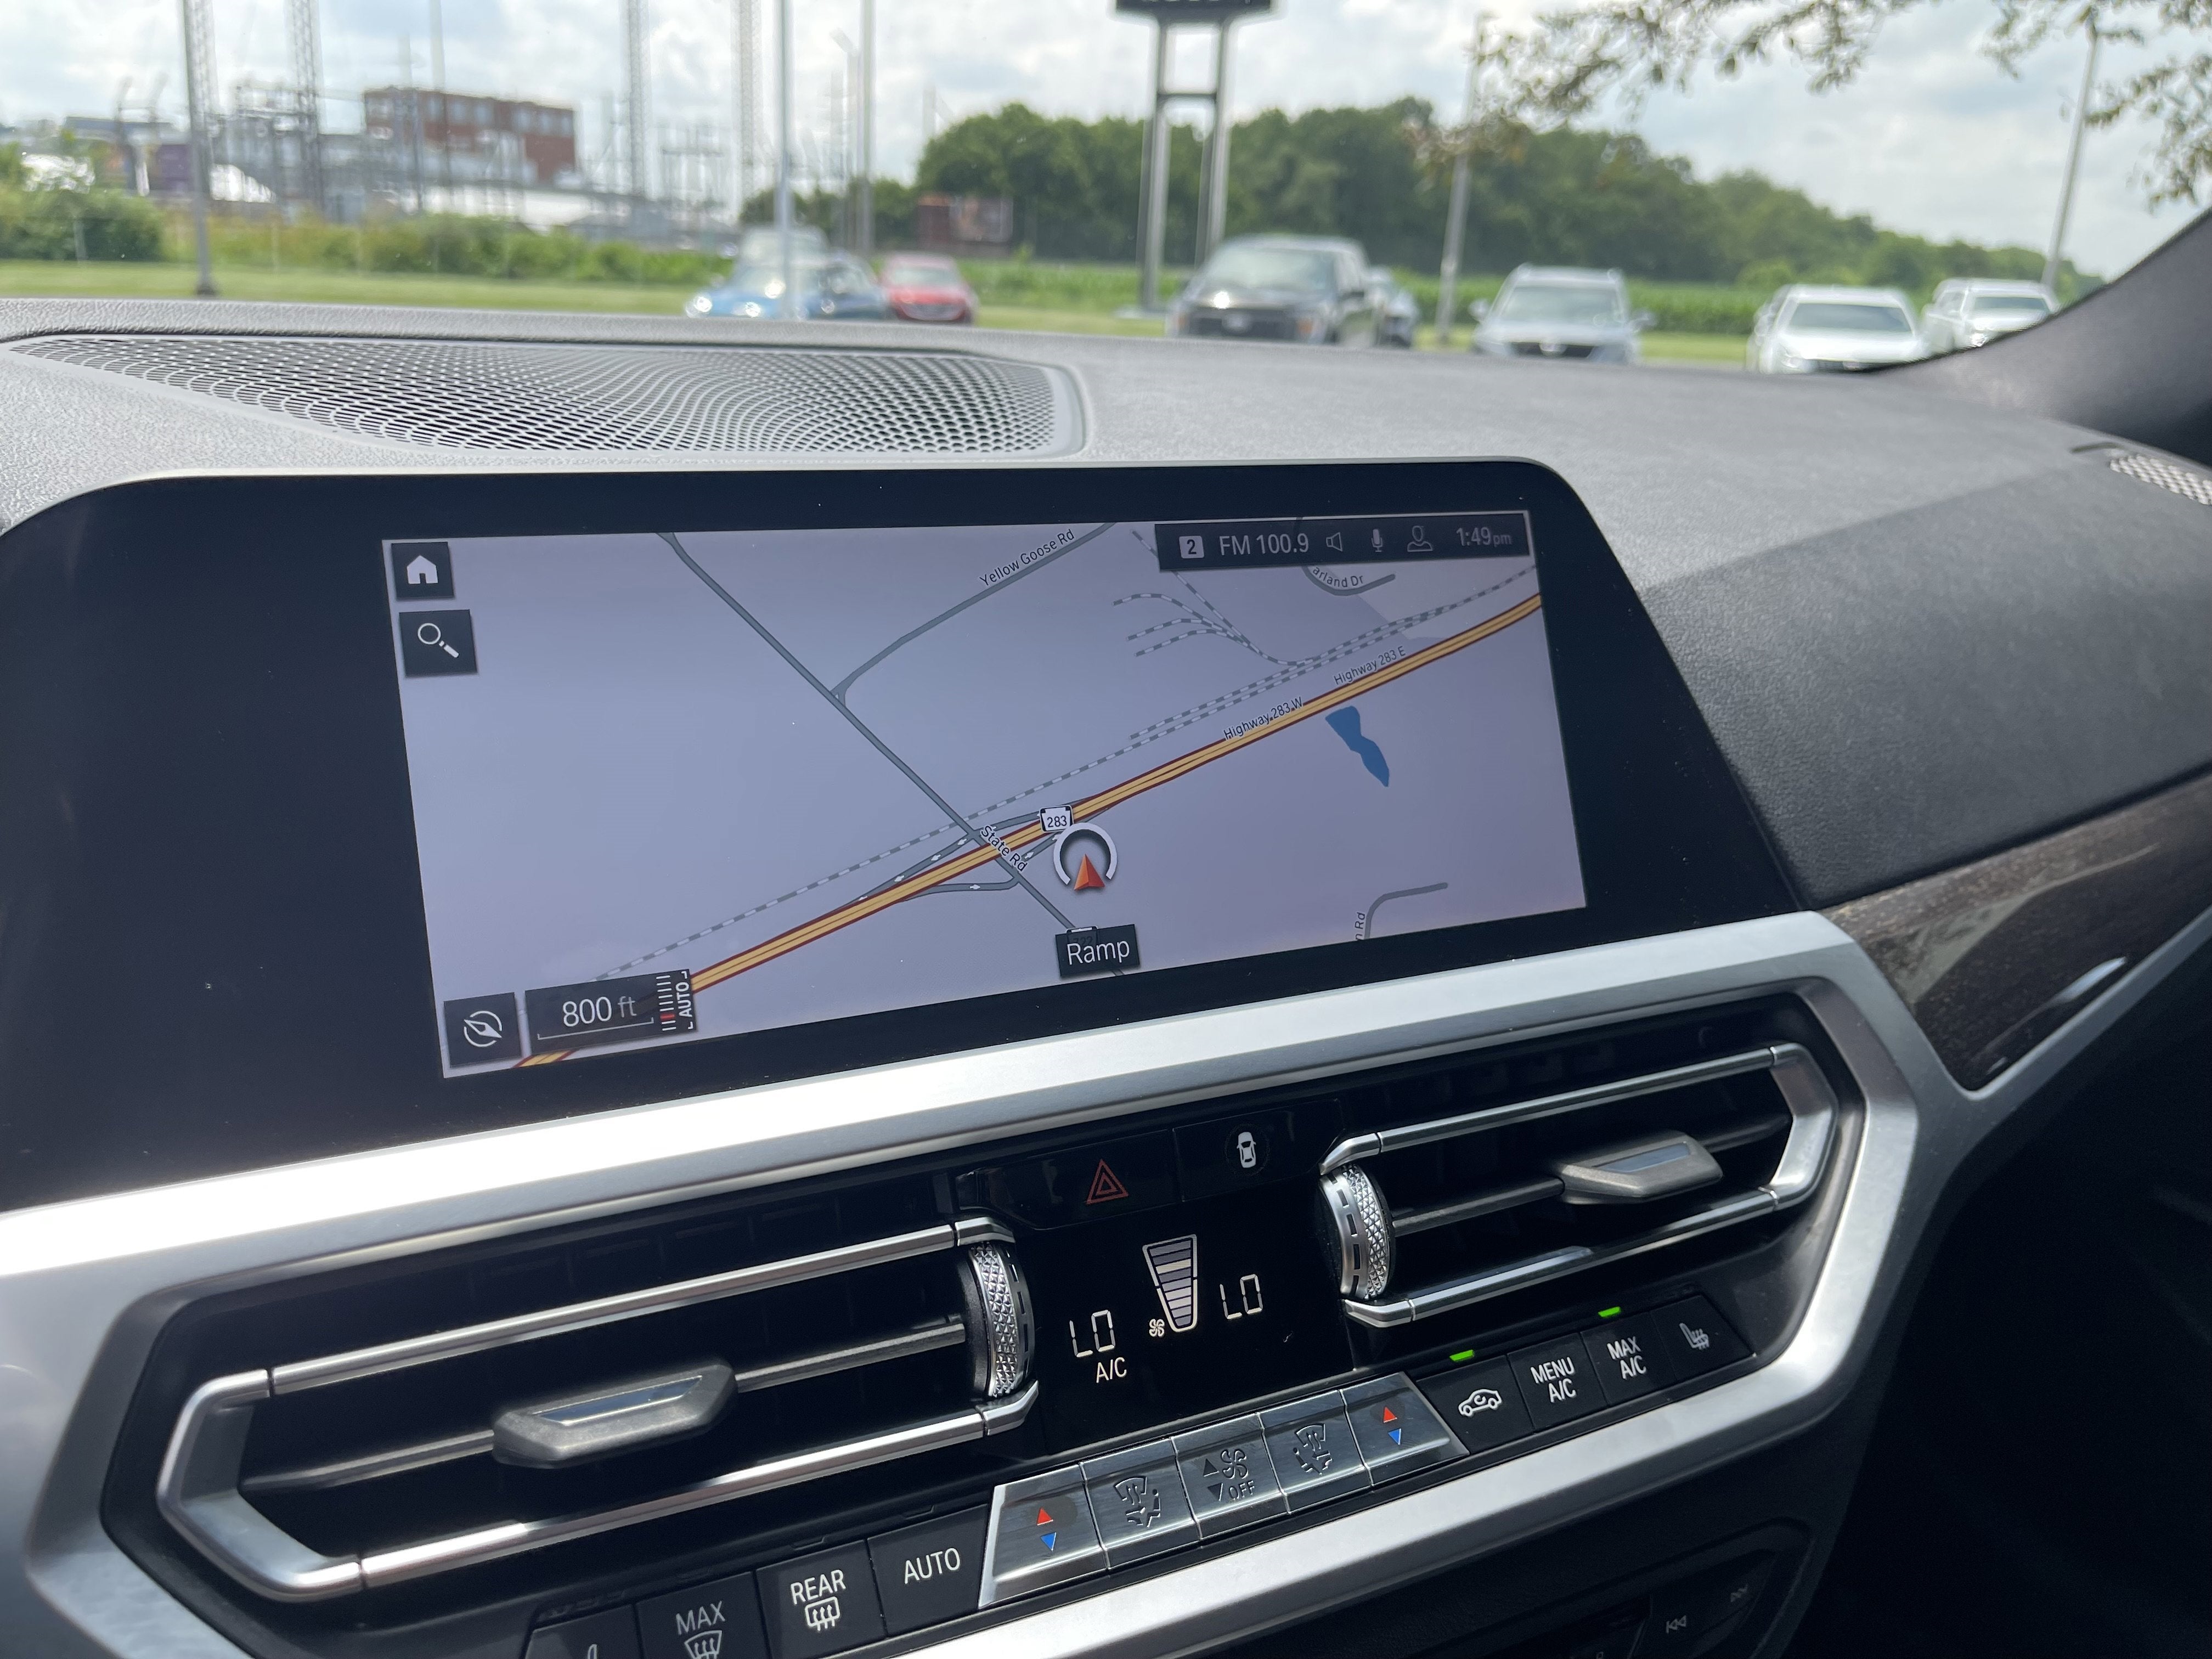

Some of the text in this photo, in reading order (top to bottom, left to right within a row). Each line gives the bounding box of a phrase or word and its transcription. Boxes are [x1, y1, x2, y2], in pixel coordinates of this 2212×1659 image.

[979, 528, 1075, 586] Yellow Goose Rd
[1185, 539, 1197, 555] 2
[1219, 533, 1310, 556] FM 100.9
[1350, 575, 1364, 586] Dr
[1333, 645, 1407, 686] Highway 283 E
[1223, 696, 1304, 741] Highway 283 W
[1047, 815, 1068, 828] 283
[981, 825, 1028, 872] State Rd
[1355, 912, 1365, 929] Rd
[1066, 939, 1131, 966] Ramp
[562, 995, 637, 1028] 800 ft
[675, 981, 693, 1019] AUTO
[1219, 1273, 1264, 1320] LO
[1069, 1309, 1116, 1358] LO
[1606, 1336, 1641, 1360] MAX
[1096, 1356, 1127, 1384] A/C
[1530, 1357, 1575, 1384] MENU
[1620, 1356, 1646, 1380] A/C
[1548, 1379, 1576, 1403] A/C
[1228, 1480, 1255, 1500] OFF
[903, 1547, 961, 1585] AUTO
[789, 1568, 847, 1605] REAR
[675, 1600, 726, 1636] MAX
